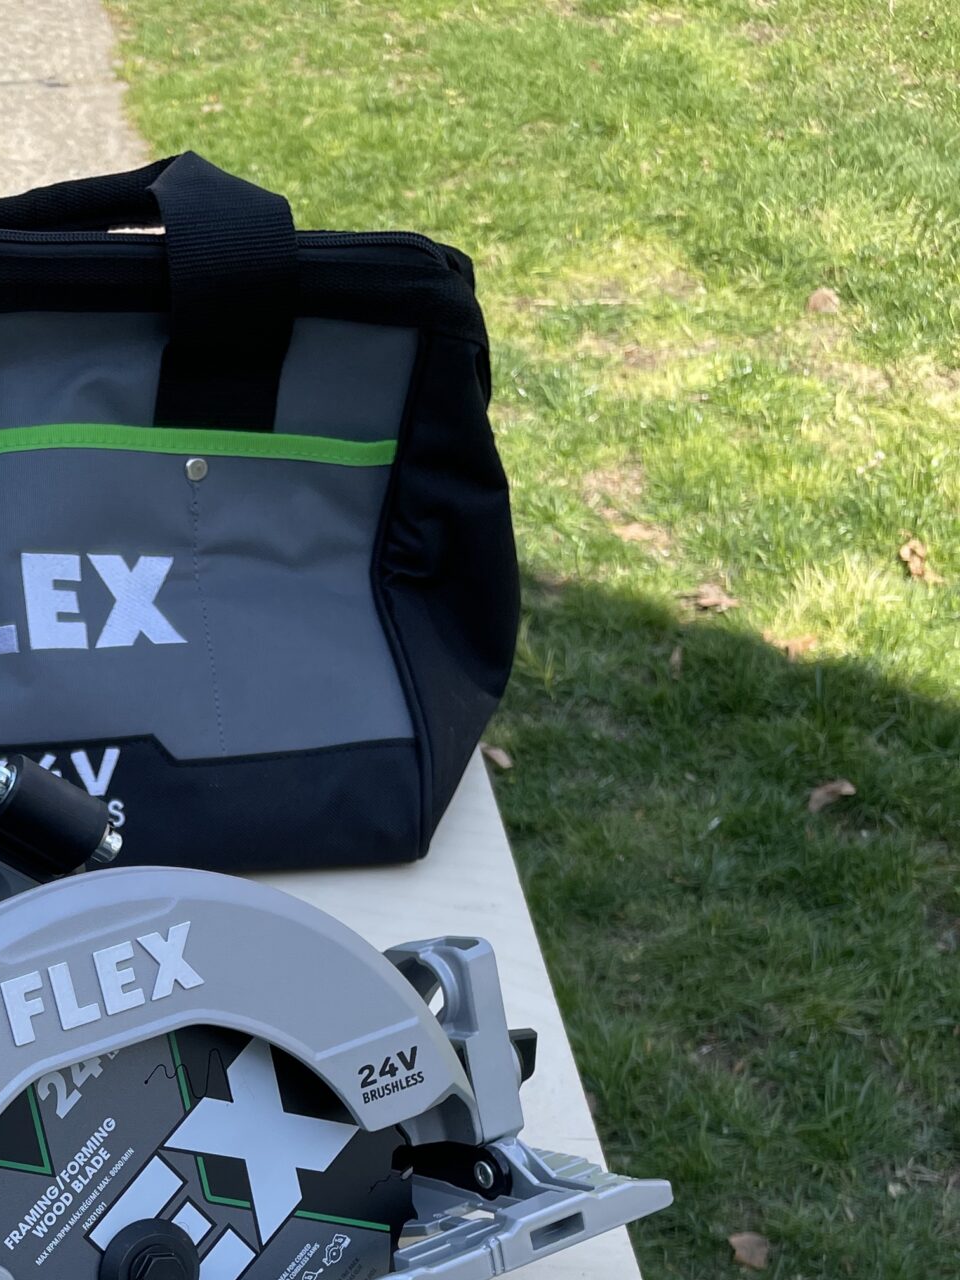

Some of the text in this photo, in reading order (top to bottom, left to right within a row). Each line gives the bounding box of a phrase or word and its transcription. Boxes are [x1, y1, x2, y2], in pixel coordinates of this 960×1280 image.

[0, 920, 205, 1047] FLEX
[37, 1050, 120, 1120] 24
[358, 1045, 418, 1089] 24V
[362, 1071, 425, 1104] BRUSHLESS
[3, 1117, 116, 1251] FRAMING/FORMING
[31, 1147, 111, 1239] WOOD BLADE
[82, 1201, 108, 1231] FA201001
[35, 1250, 50, 1266] MAX
[286, 1261, 297, 1273] FOR
[294, 1243, 312, 1263] CORDED
[289, 1255, 310, 1280] CORDLESS
